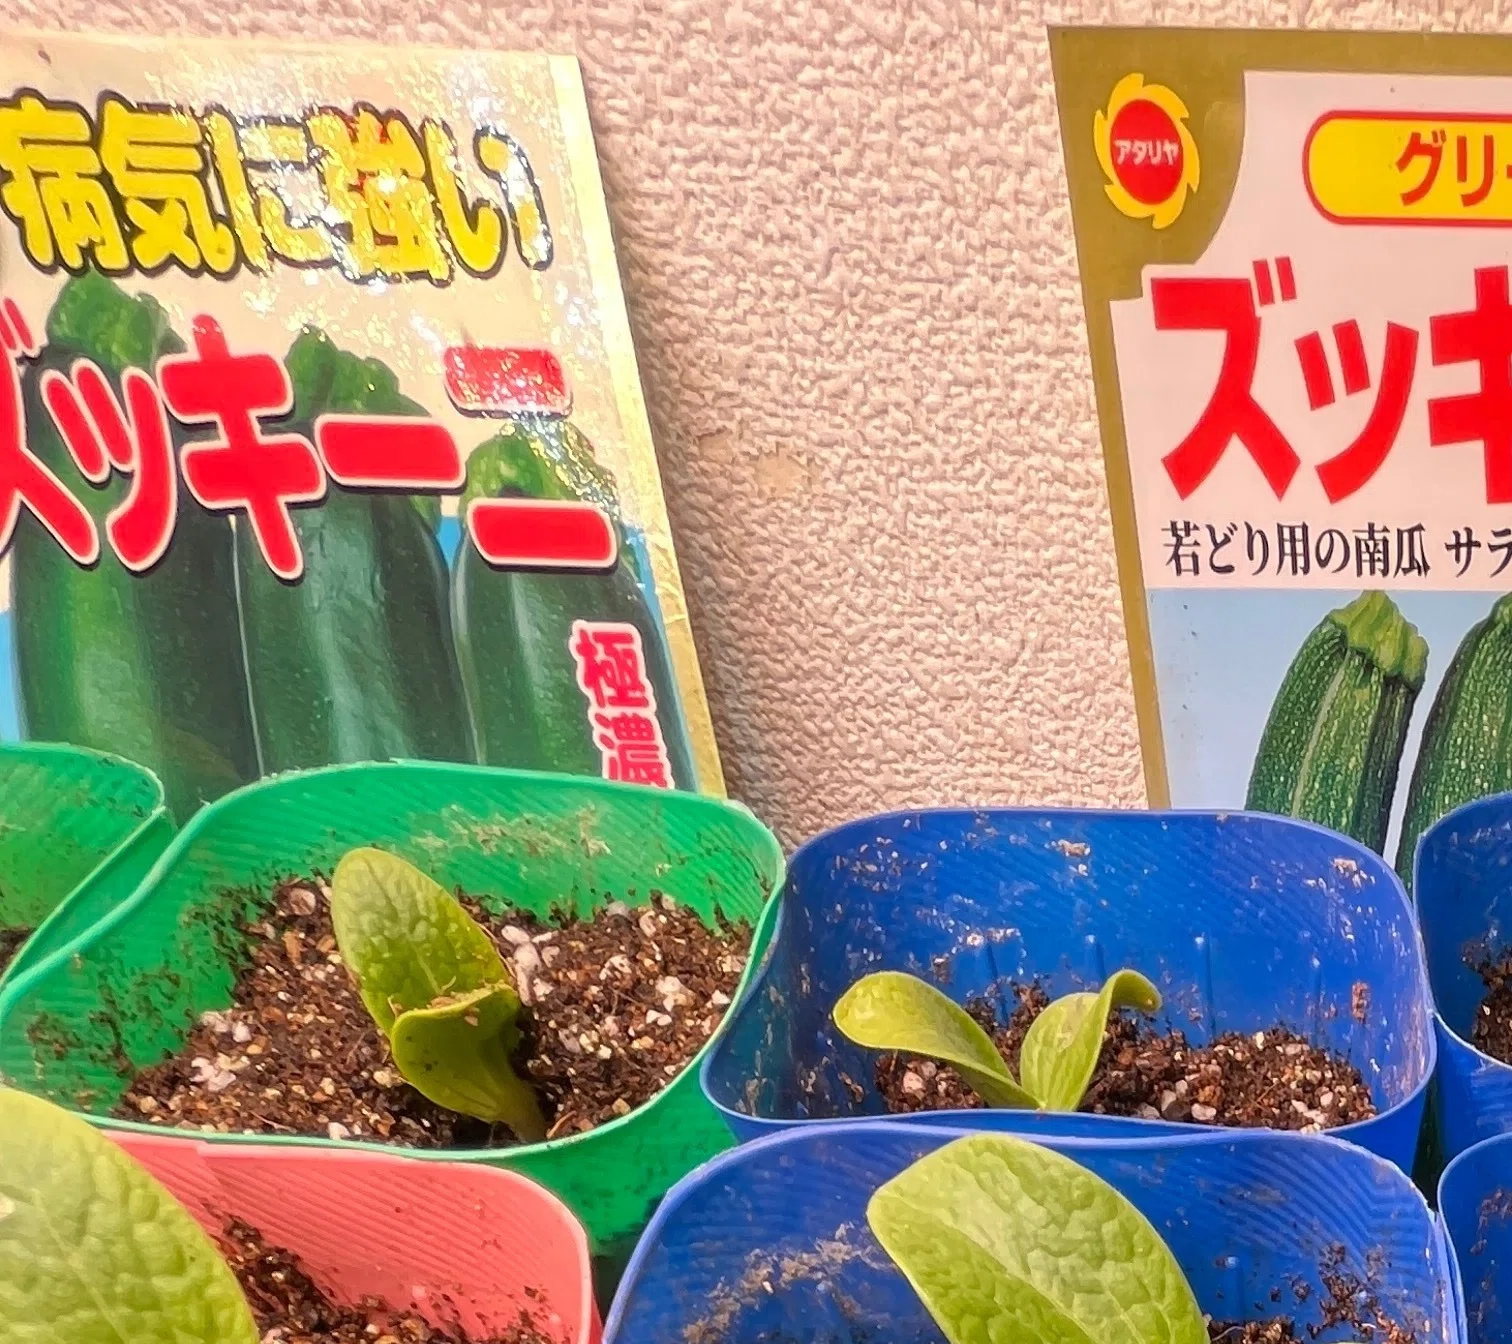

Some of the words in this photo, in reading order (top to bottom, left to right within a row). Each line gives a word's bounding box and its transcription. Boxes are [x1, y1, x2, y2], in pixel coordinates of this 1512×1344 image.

[1113, 138, 1180, 167] アタリヤ
[0, 88, 552, 284] 病気に強い
[1161, 520, 1430, 579] 若どり用の南瓜
